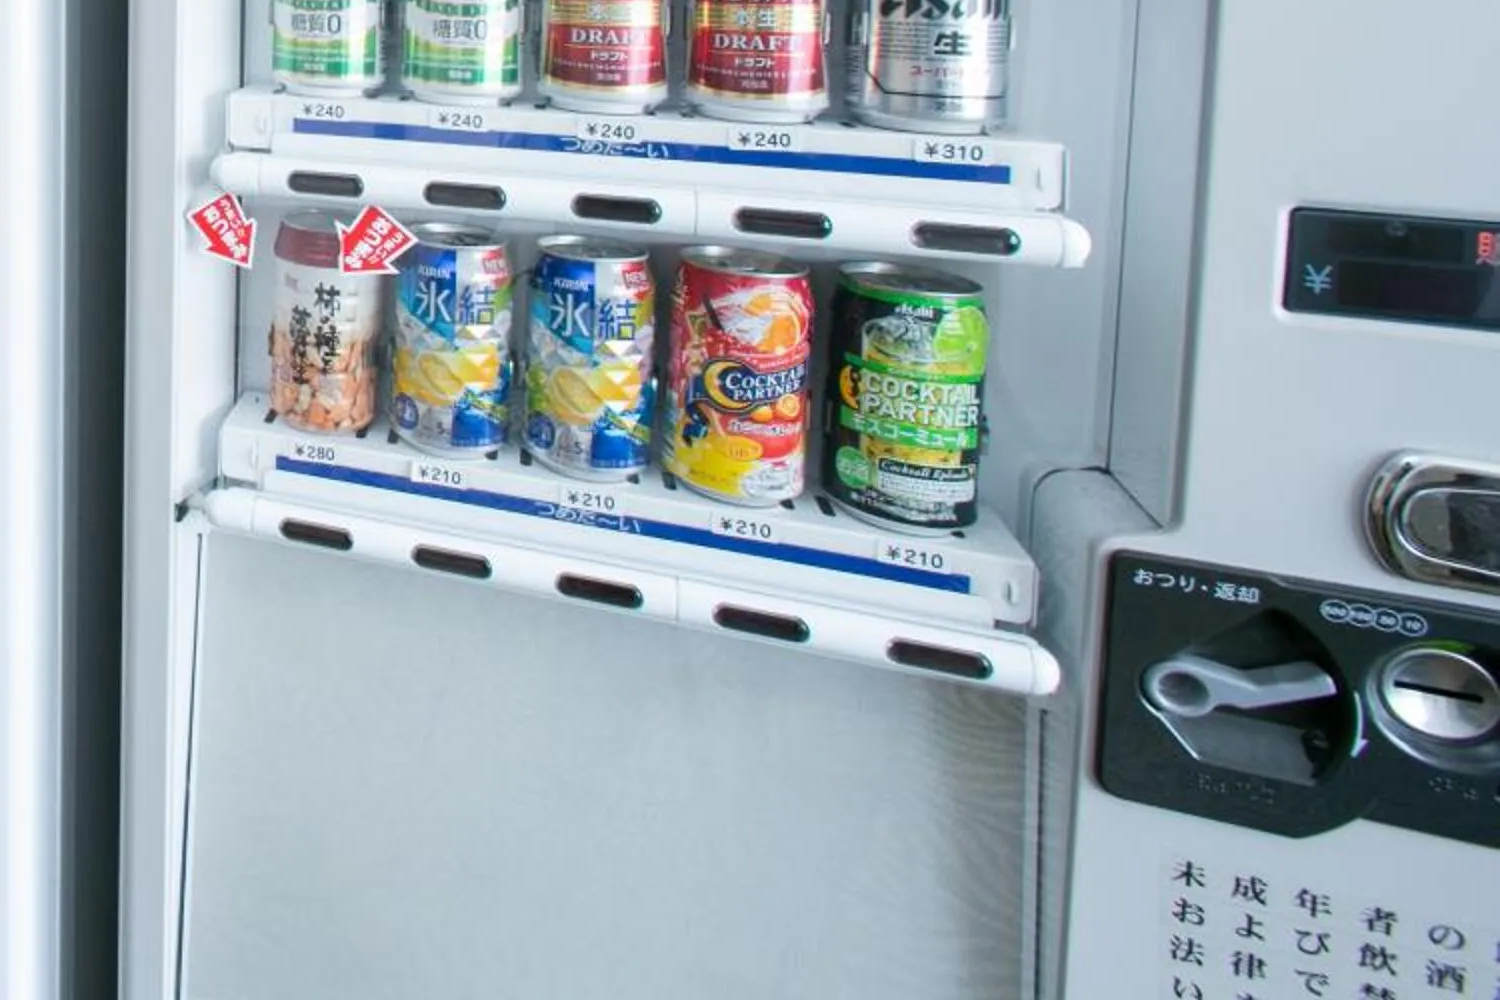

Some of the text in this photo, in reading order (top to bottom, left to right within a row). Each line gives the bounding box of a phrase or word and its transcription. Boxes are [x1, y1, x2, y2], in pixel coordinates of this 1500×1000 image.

[713, 33, 798, 52] DRAFT
[934, 31, 974, 57] 生
[303, 103, 345, 119] ¥240
[438, 112, 484, 129] ¥240
[586, 122, 636, 140] ¥240
[737, 131, 792, 149] ¥240
[924, 142, 984, 161] ¥310
[1303, 264, 1332, 294] ¥
[416, 283, 497, 326] 氷結
[549, 294, 638, 341] 氷結
[864, 371, 980, 406] COCKTAIL
[863, 395, 979, 428] PARTNER
[294, 444, 336, 461] ¥280
[419, 466, 462, 485] ¥210
[566, 489, 616, 511] ¥210
[720, 516, 772, 539] ¥210
[886, 546, 944, 569] ¥210
